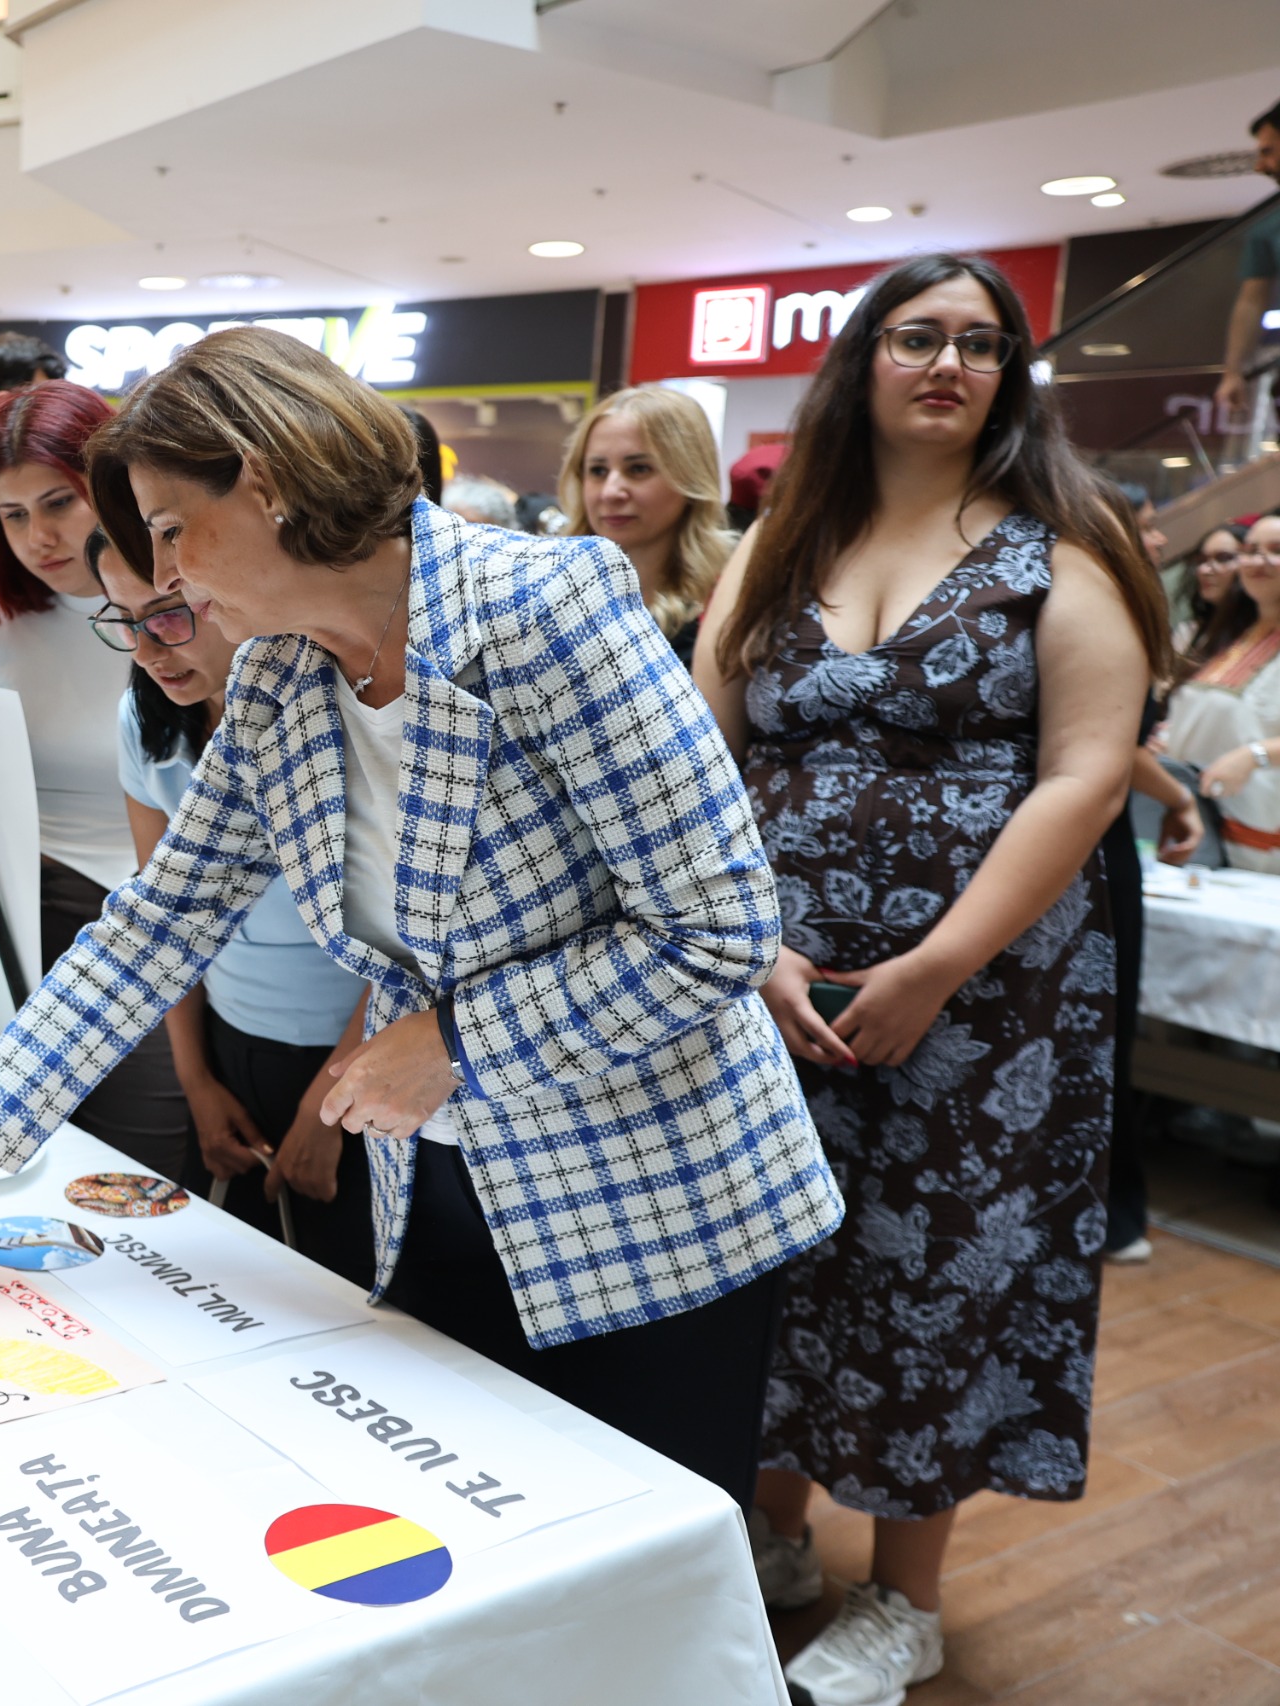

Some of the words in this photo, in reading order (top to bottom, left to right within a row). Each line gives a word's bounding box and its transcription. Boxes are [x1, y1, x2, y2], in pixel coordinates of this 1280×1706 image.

[65, 301, 427, 391] SPOVE
[289, 1370, 459, 1472] IUBESC
[445, 1471, 526, 1518] TE
